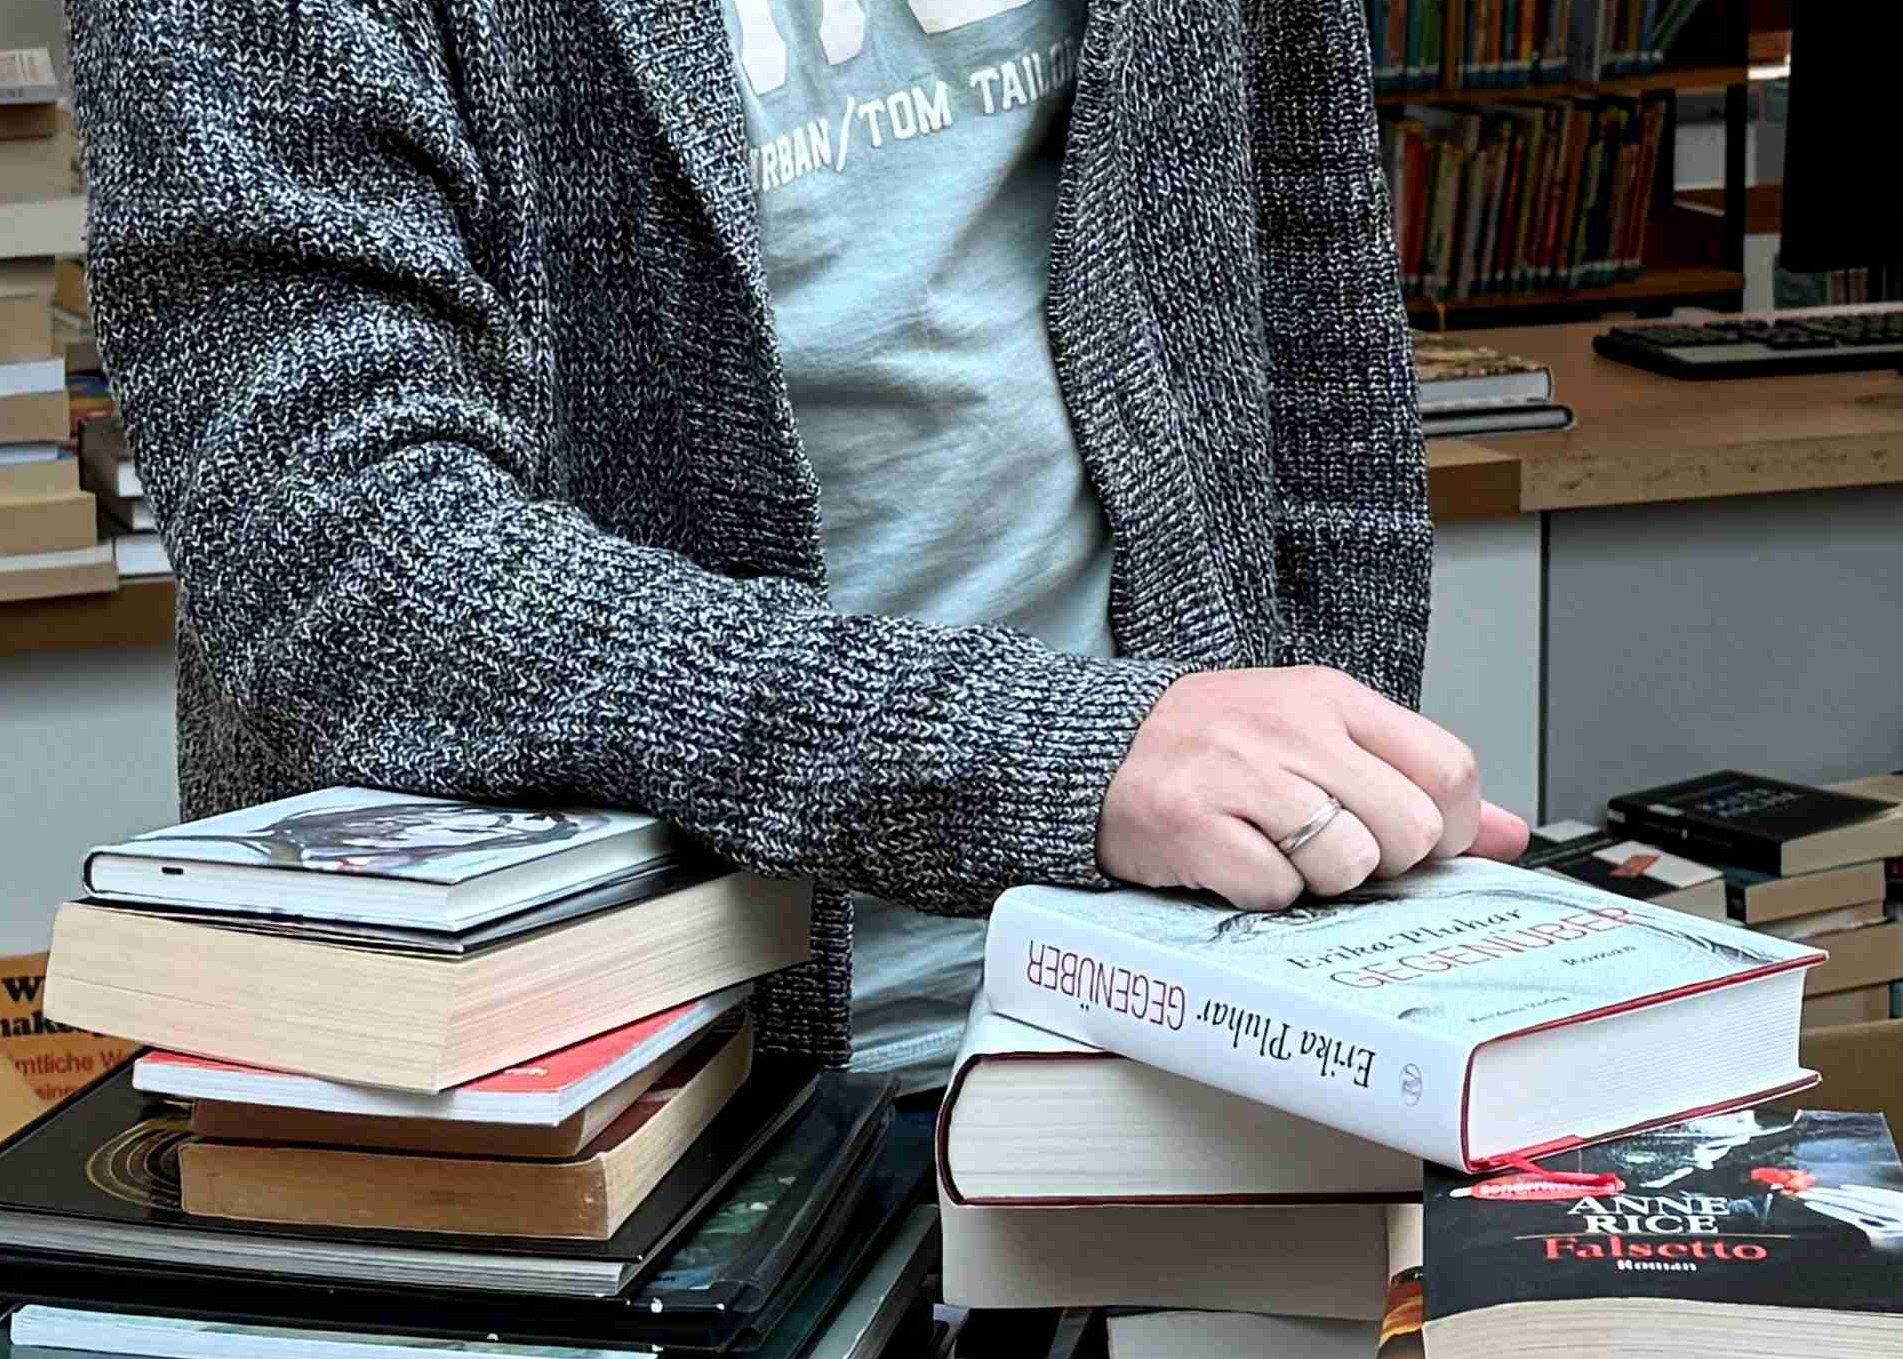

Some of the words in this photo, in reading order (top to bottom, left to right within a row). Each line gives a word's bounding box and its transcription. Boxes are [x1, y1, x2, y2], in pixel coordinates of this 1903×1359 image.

[1285, 938, 1394, 970] Erika
[1397, 906, 1522, 945] Pluhar
[1329, 906, 1630, 989] GEGENÜBER
[1026, 939, 1186, 1031] GEGENÜBER
[1195, 998, 1293, 1061] Pluhar
[1300, 1028, 1377, 1088] Erika
[1566, 1194, 1731, 1216] ANNE
[1585, 1214, 1720, 1234] RICE
[1545, 1235, 1769, 1261] Falsetto
[1616, 1258, 1697, 1272] Roman
